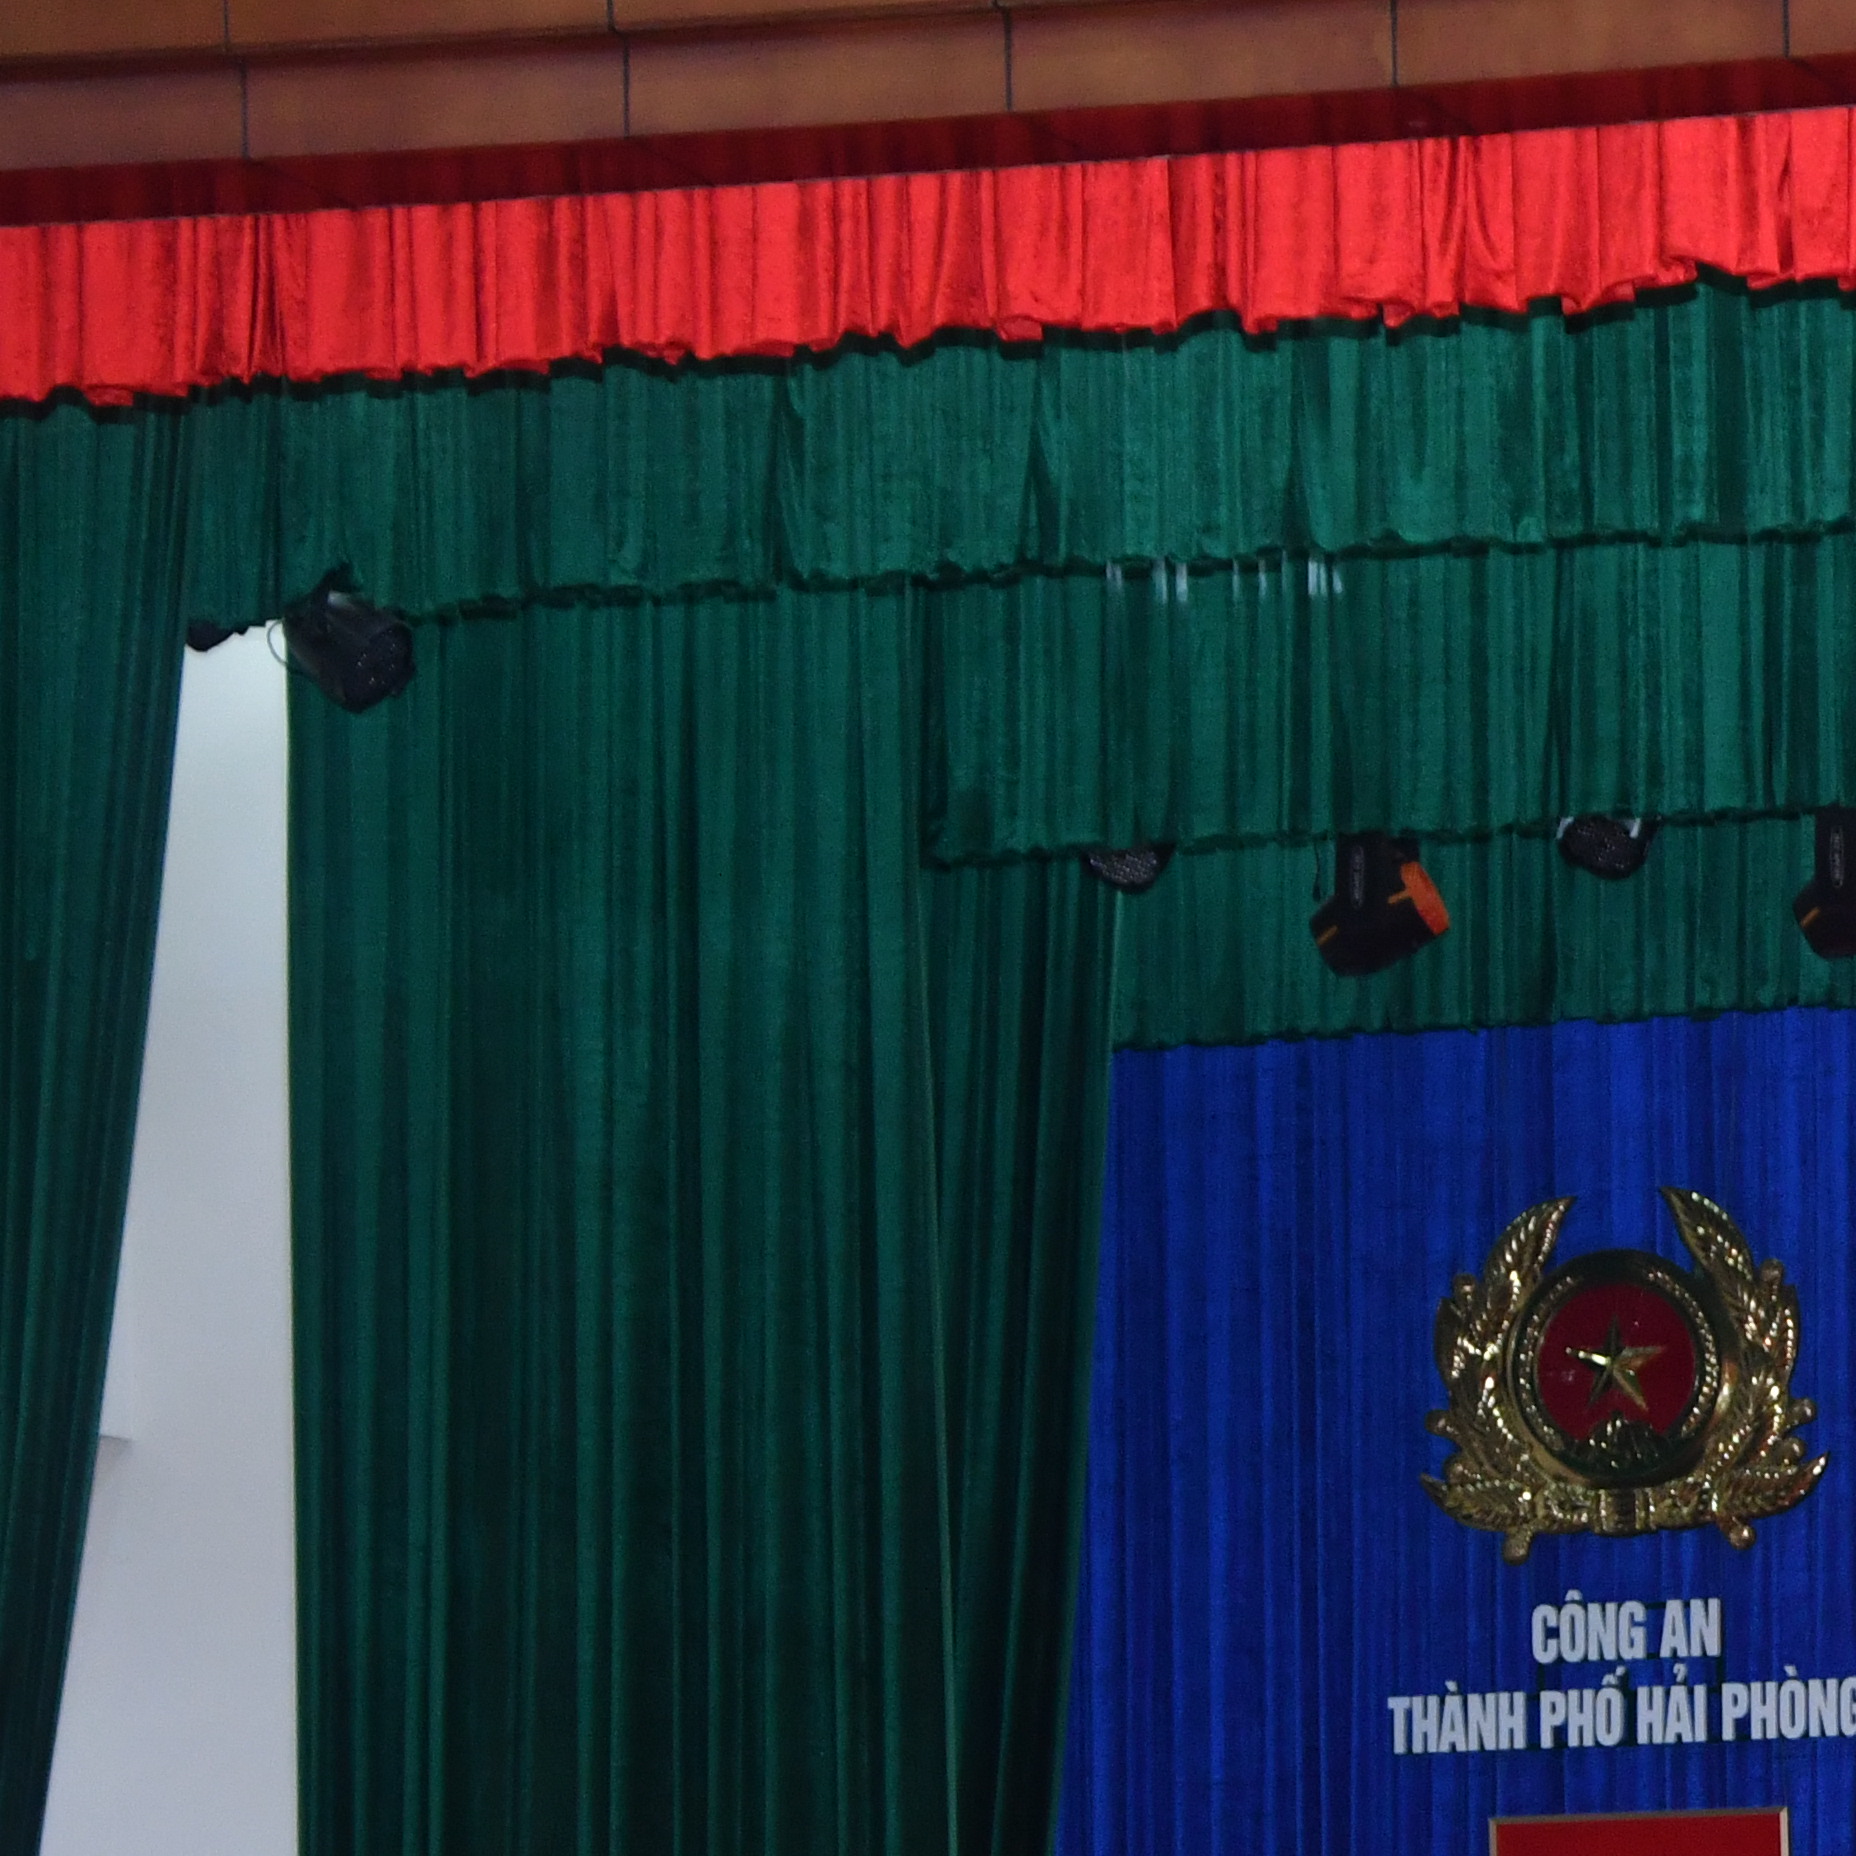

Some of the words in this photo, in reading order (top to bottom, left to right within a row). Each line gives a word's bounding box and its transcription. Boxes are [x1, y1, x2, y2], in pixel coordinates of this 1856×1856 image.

[1532, 1590, 1646, 1664] CÔNG
[1659, 1598, 1721, 1657] AN
[1388, 1681, 1527, 1755] THÀNH
[1539, 1666, 1628, 1749] PHỐ
[1637, 1663, 1708, 1744] HẢI
